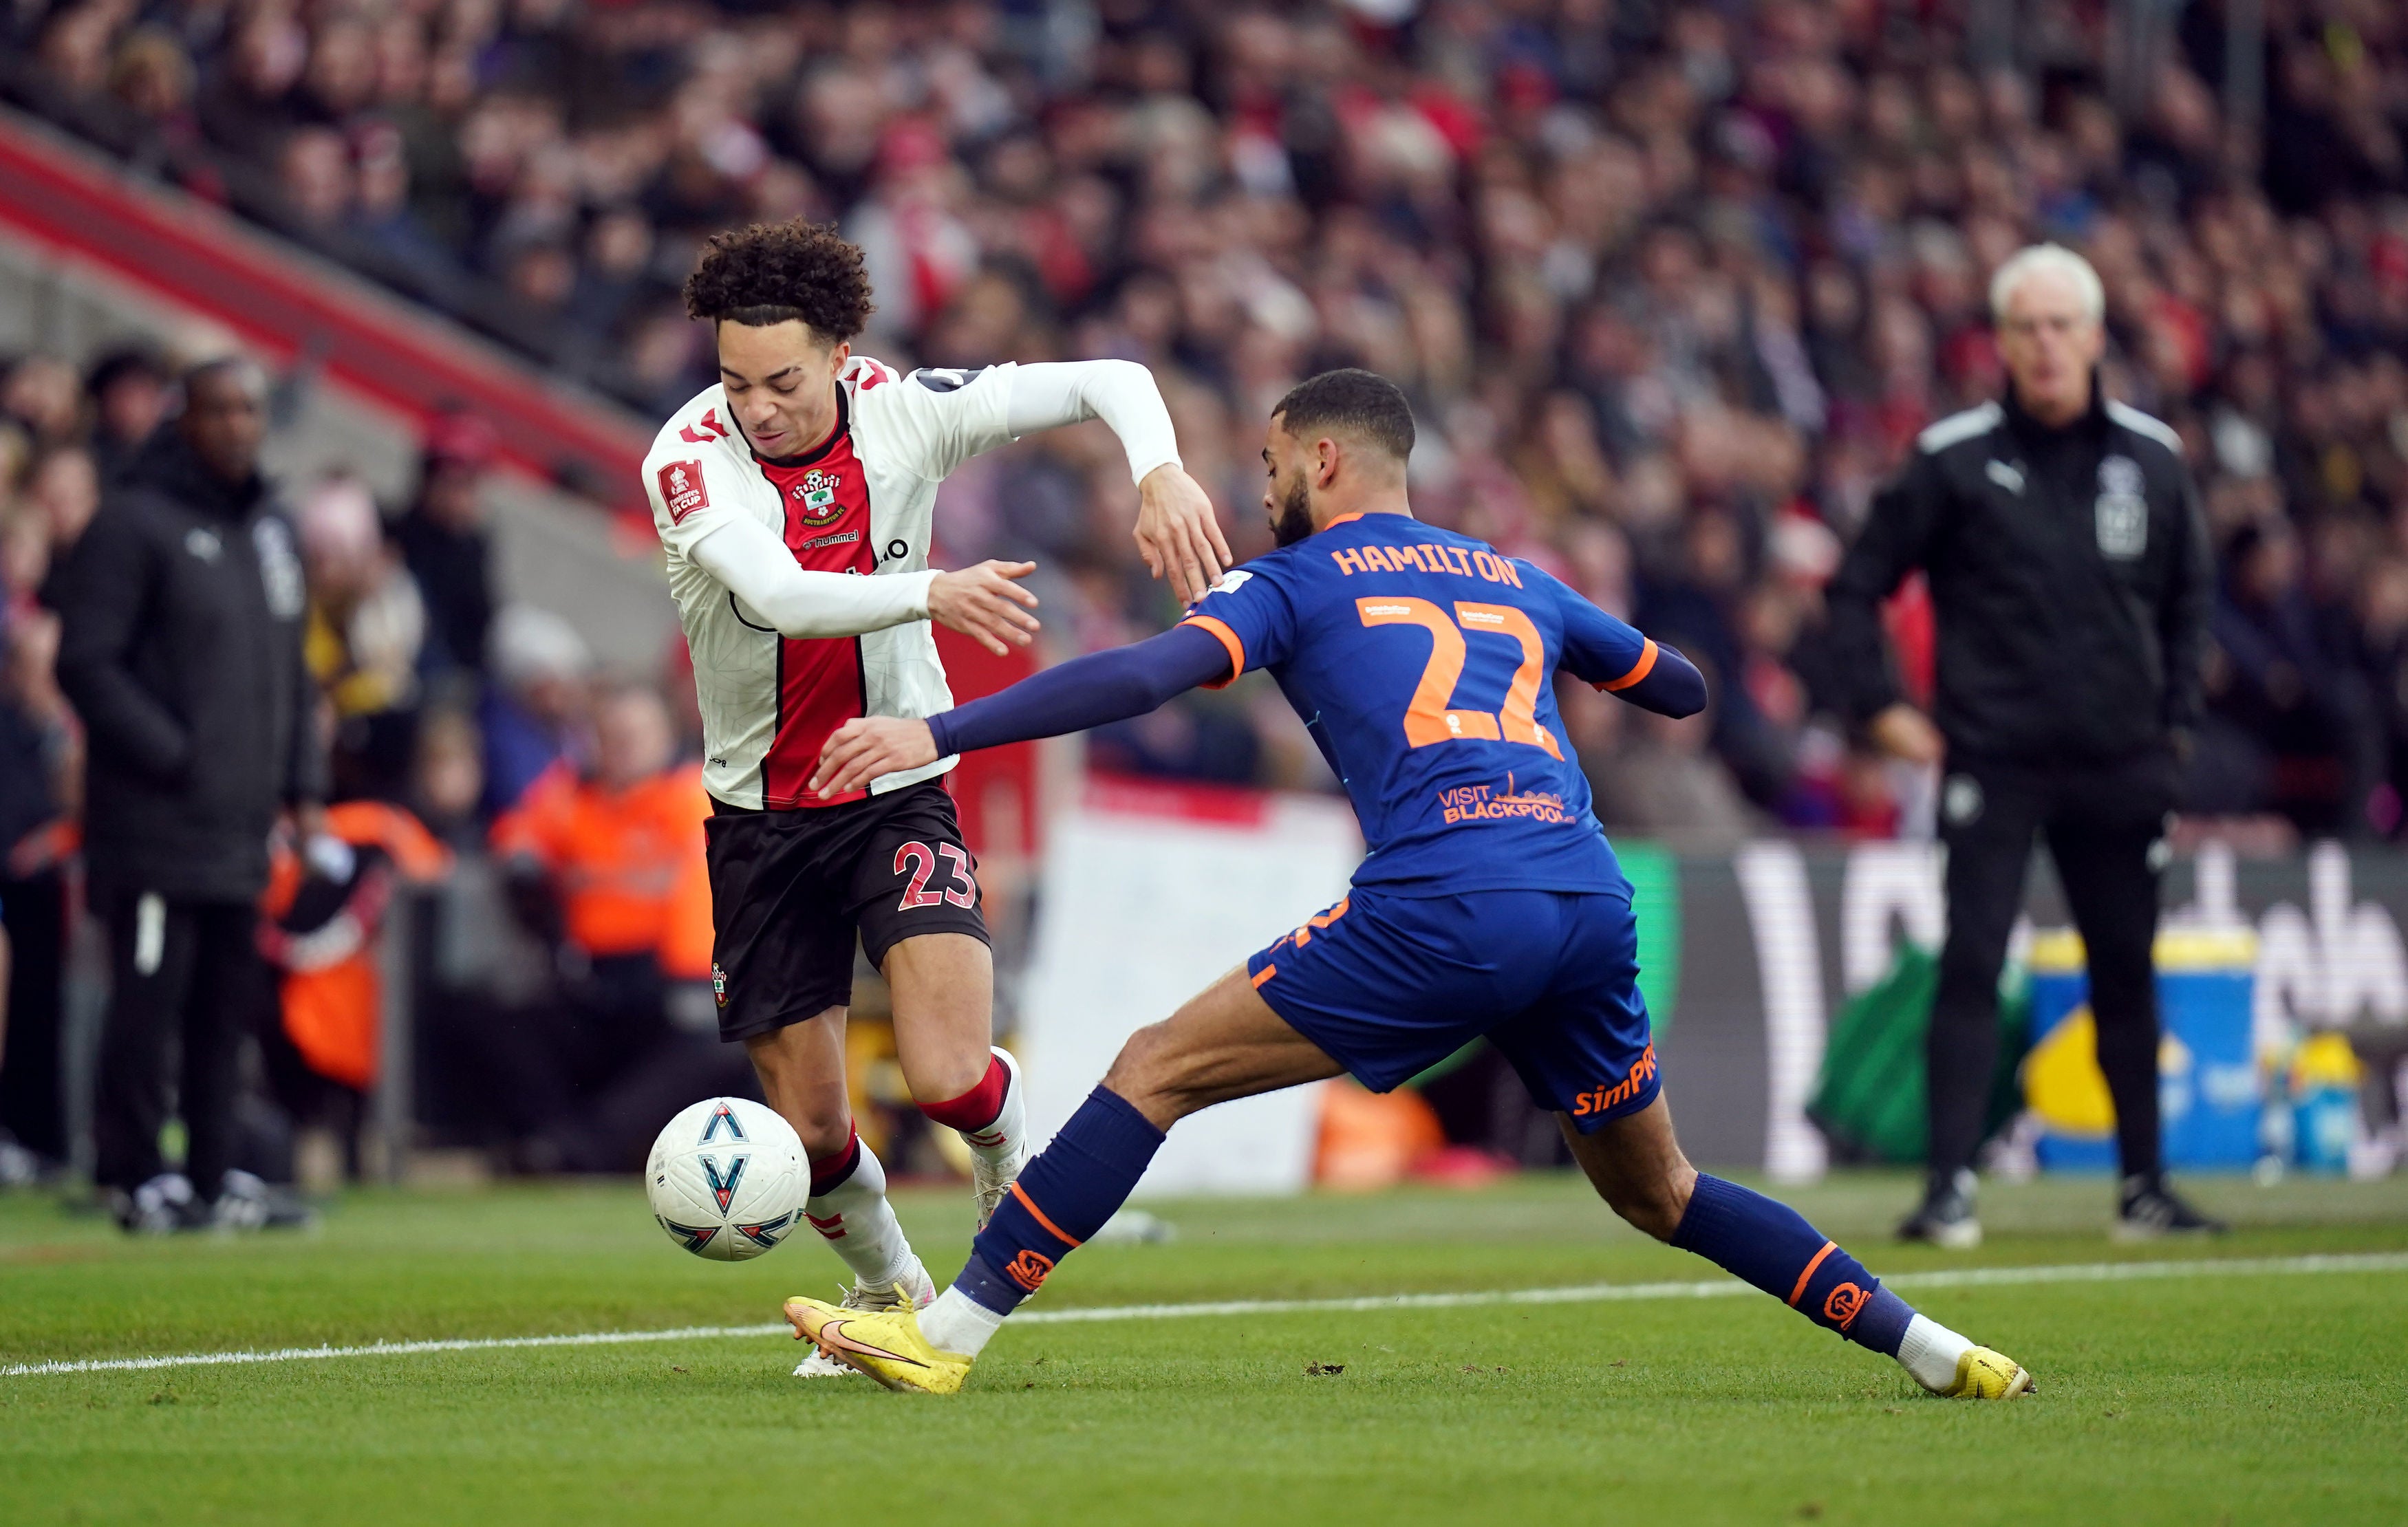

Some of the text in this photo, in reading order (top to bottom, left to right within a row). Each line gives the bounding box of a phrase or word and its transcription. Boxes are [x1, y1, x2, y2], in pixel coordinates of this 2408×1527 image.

[680, 495, 701, 509] CUP
[815, 529, 859, 548] hummel
[1331, 544, 1523, 589] HAMILTON
[1355, 596, 1565, 762] 22
[1438, 786, 1491, 808] VISIT
[894, 841, 976, 911] 23
